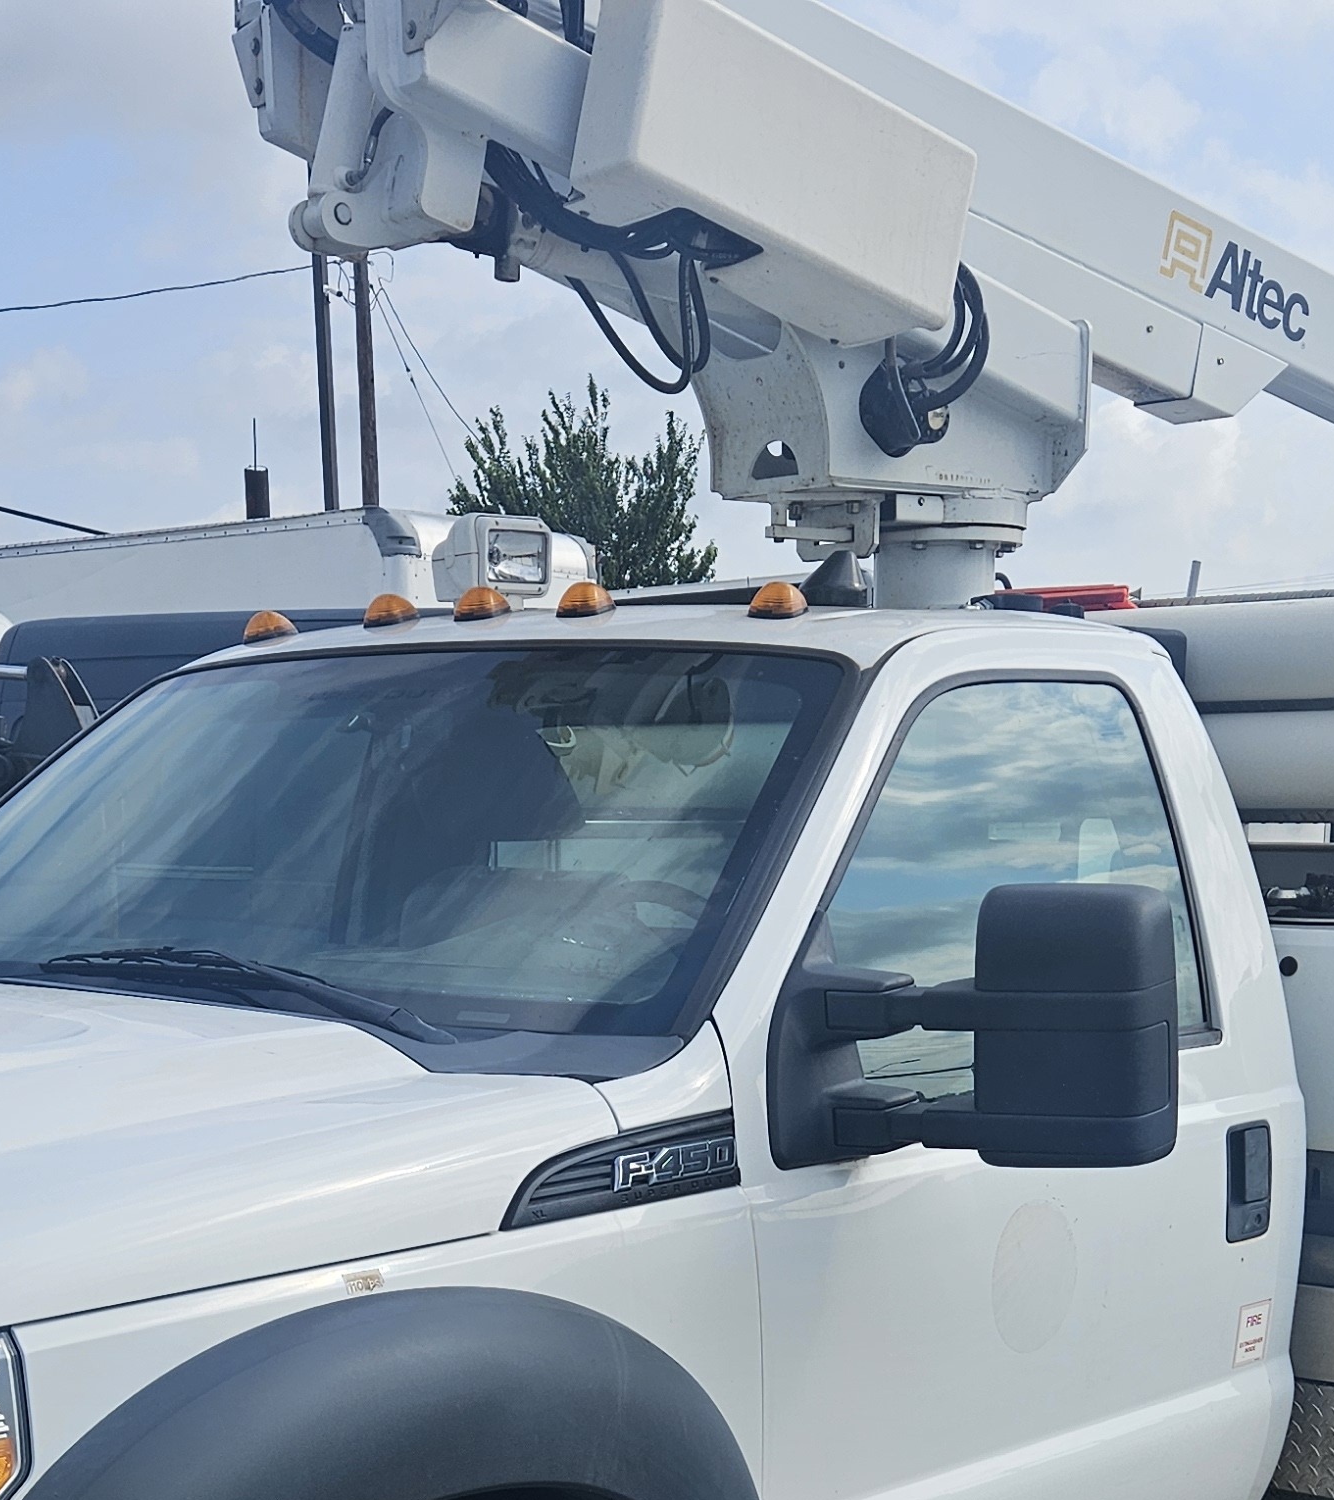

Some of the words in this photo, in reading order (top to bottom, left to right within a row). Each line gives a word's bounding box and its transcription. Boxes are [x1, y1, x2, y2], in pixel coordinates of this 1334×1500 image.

[1204, 240, 1309, 342] Altec
[613, 1136, 738, 1193] F-450
[620, 1184, 681, 1204] SUPER
[531, 1209, 547, 1220] XL
[1246, 1313, 1263, 1328] FIRE
